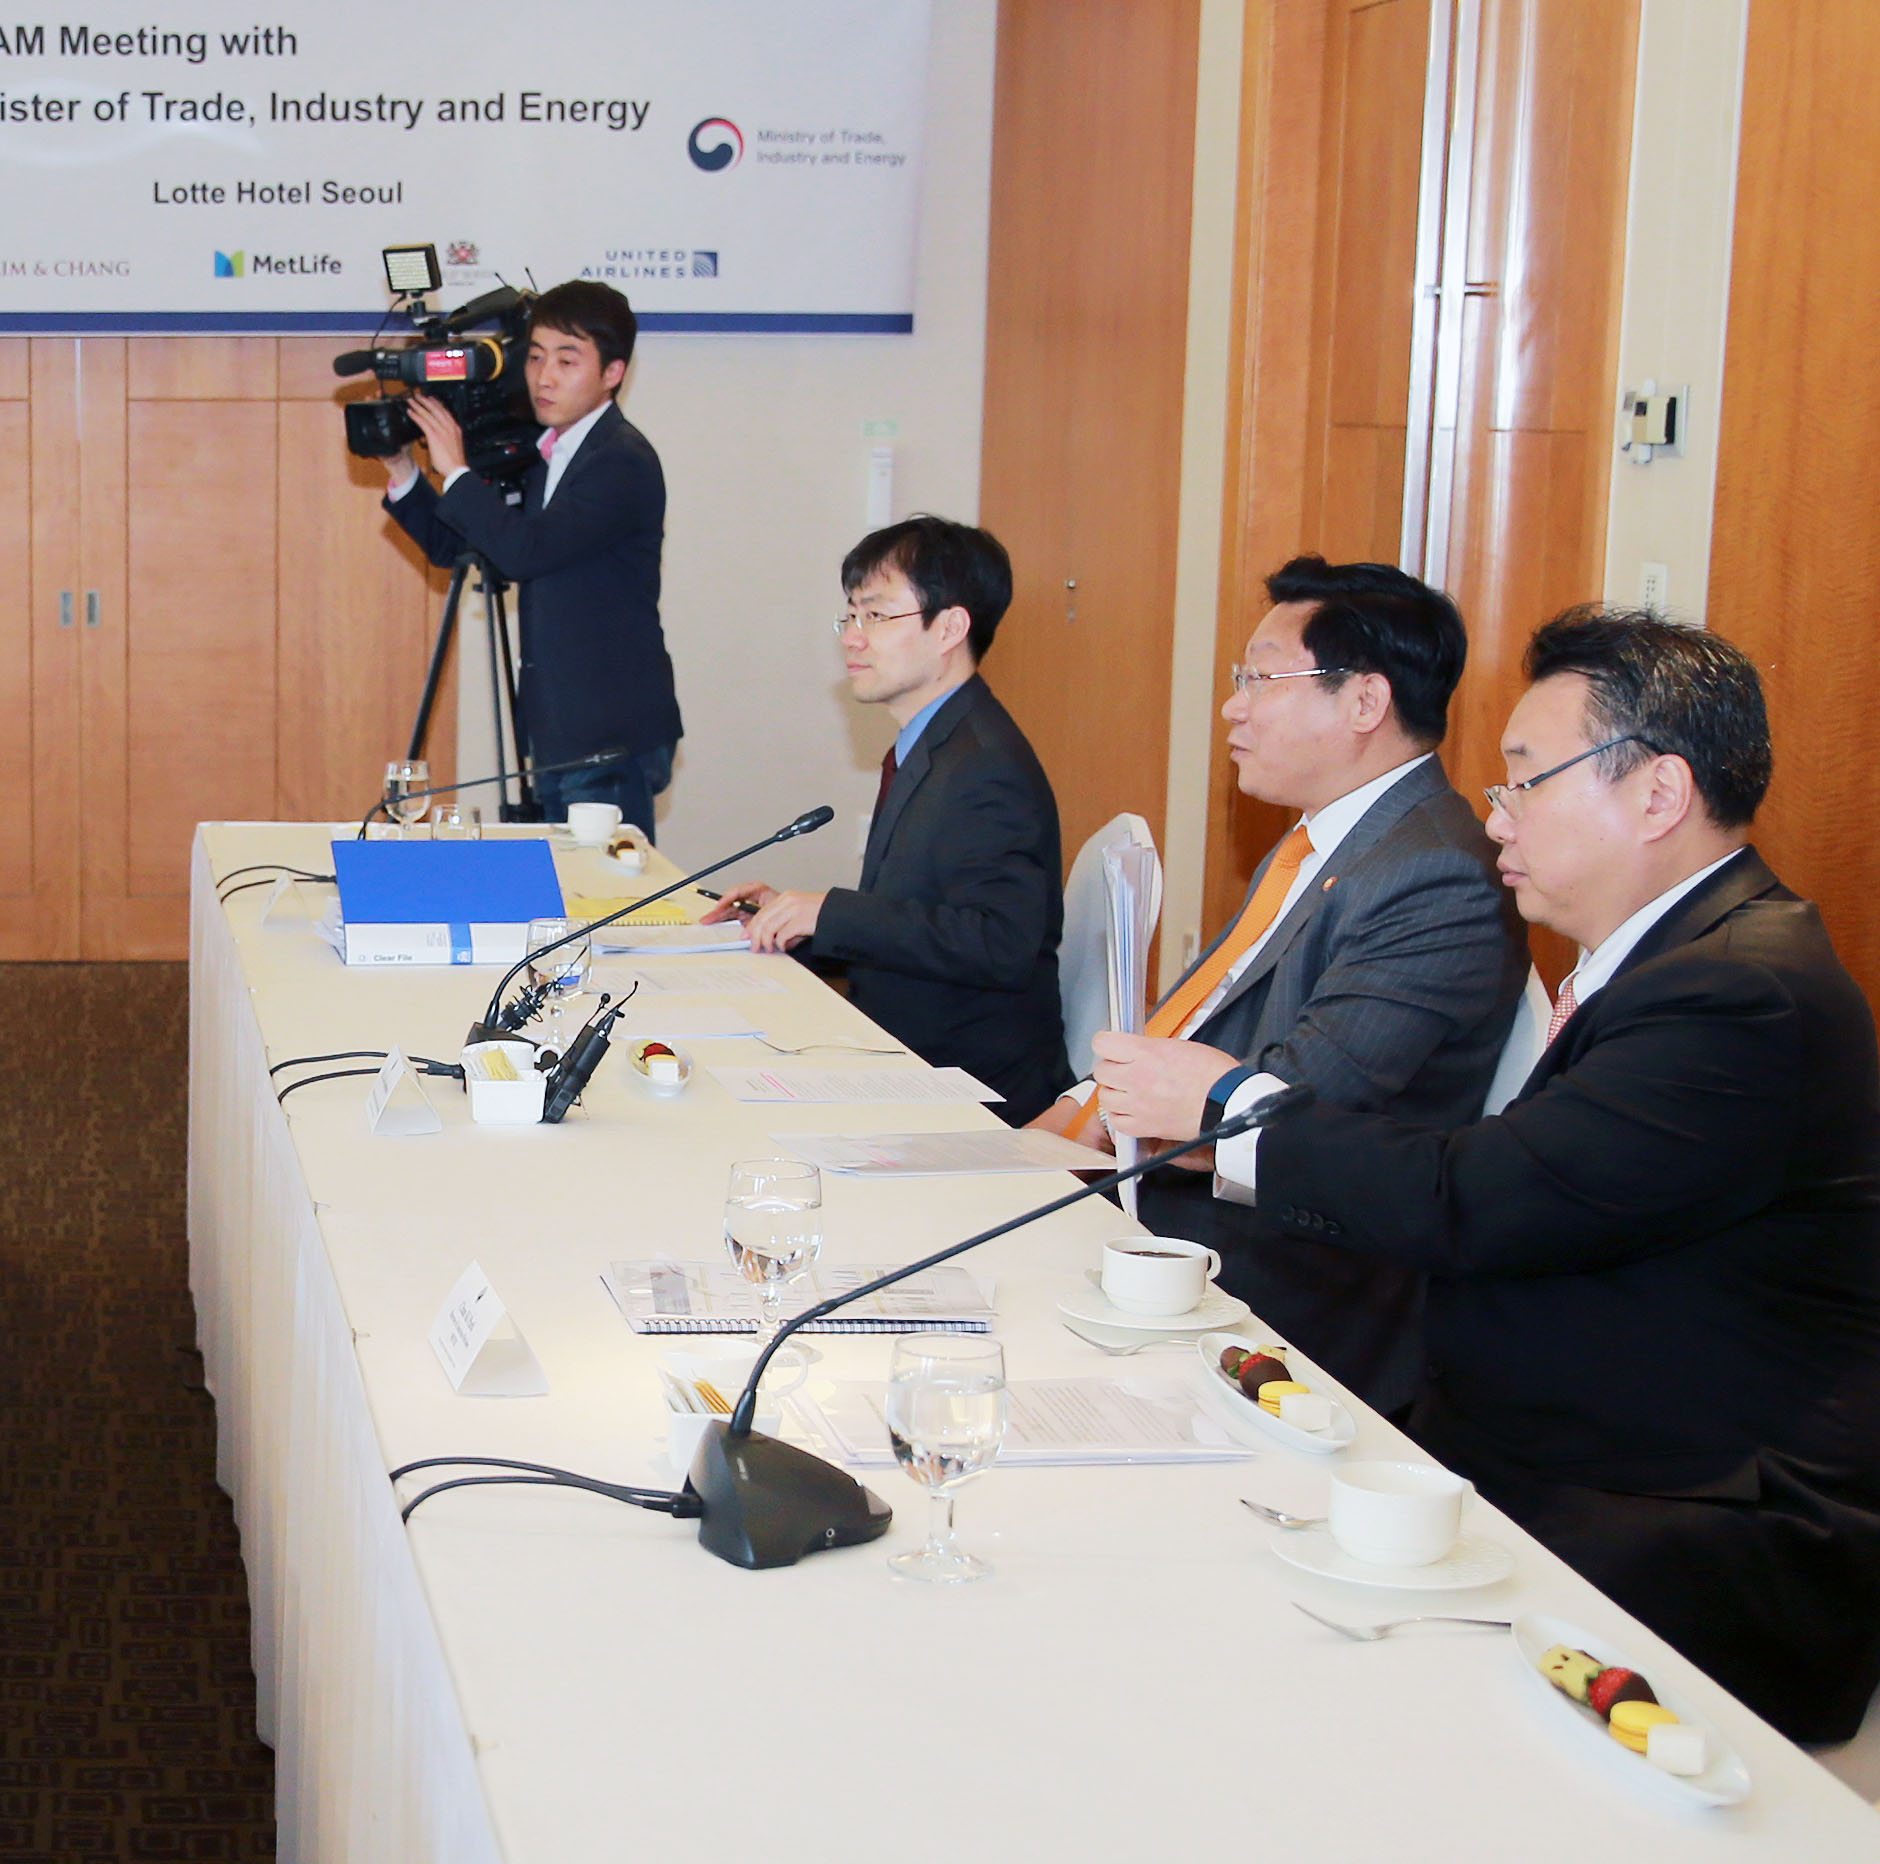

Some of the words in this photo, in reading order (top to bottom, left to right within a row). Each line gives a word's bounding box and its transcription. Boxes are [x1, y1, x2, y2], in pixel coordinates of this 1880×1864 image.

[60, 24, 207, 65] Meeting
[220, 24, 297, 56] with
[93, 91, 131, 123] of
[141, 91, 256, 128] Trade,
[270, 91, 424, 131] Industry
[437, 91, 505, 123] and
[519, 91, 651, 132] Energy
[757, 130, 816, 146] Ministry
[819, 130, 836, 144] of
[757, 151, 817, 166] Industry
[821, 151, 851, 165] and
[854, 151, 907, 167] Energy
[153, 180, 226, 205] Lotte
[236, 180, 311, 205] Hotel
[321, 180, 403, 205] Seoul
[605, 250, 686, 262] UNITED
[33, 261, 48, 277] &
[53, 260, 131, 277] CHANG
[252, 254, 343, 276] MetLife
[581, 265, 686, 279] AIRLINES
